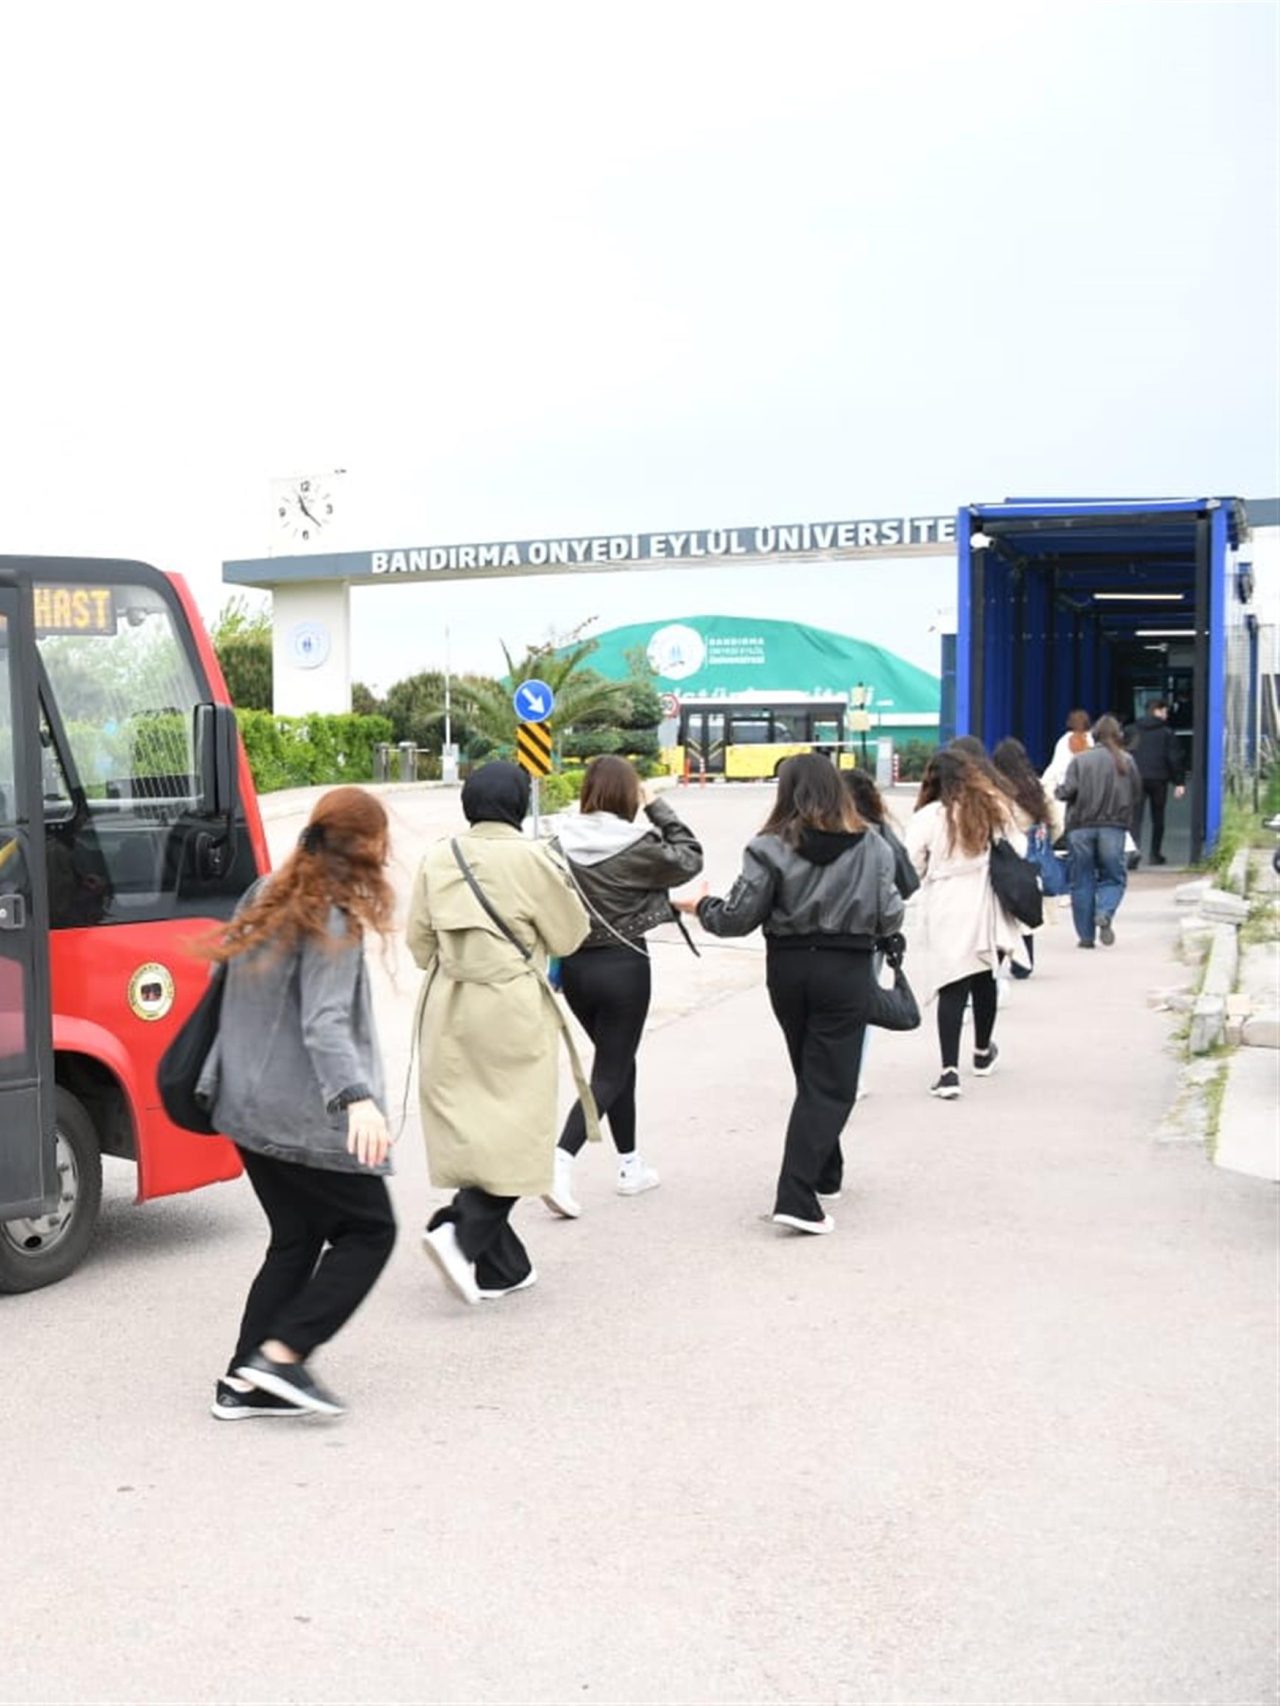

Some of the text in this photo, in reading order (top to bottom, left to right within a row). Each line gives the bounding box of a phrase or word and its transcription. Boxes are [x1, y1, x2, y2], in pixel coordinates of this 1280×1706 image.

[300, 480, 311, 493] 12
[371, 516, 956, 574] BANDIRMA ONYEDİ EYLÜL ÜNİVERSİTE
